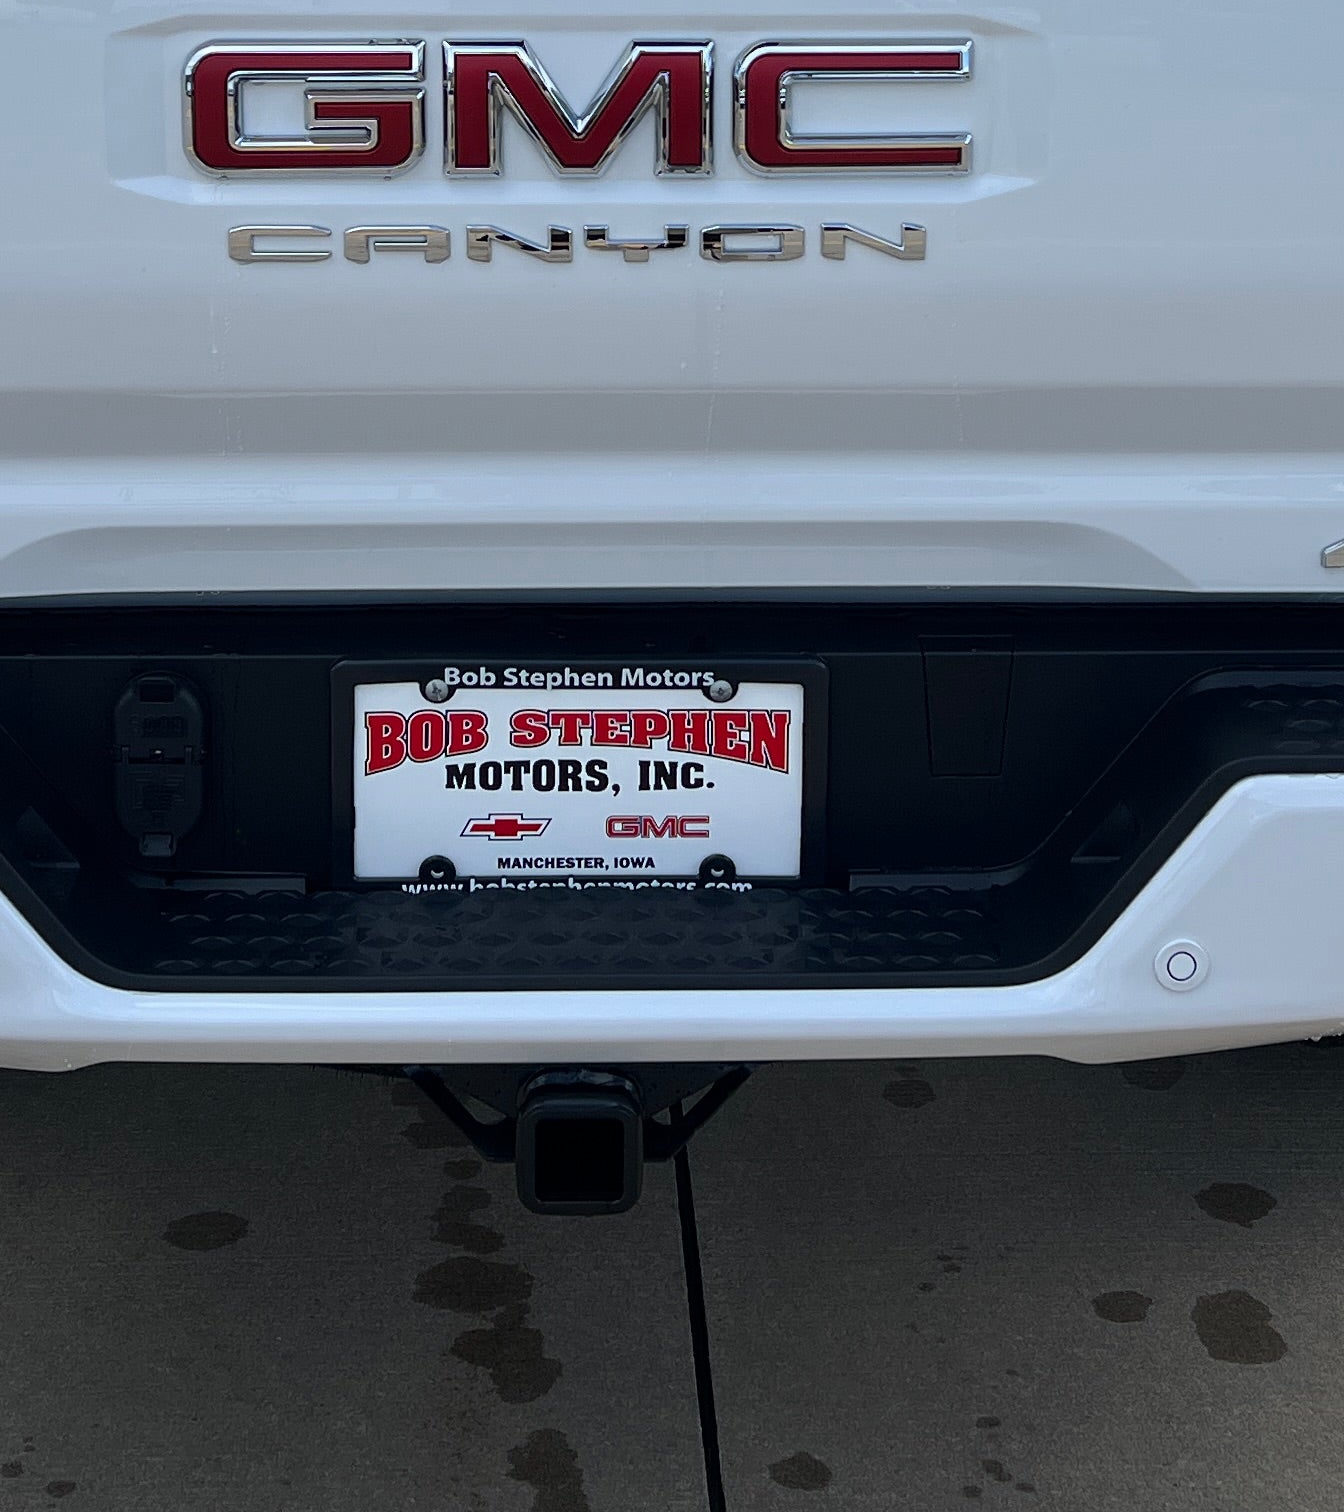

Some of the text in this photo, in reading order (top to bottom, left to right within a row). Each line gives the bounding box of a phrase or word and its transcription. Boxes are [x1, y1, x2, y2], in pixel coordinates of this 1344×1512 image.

[182, 37, 975, 179] GMC
[227, 222, 928, 265] CANYON
[444, 667, 715, 691] Bob Stephen Motors
[364, 708, 792, 775] BOB STEPHEN
[444, 759, 716, 797] MOTORS, INC.
[605, 814, 711, 840] GMC
[496, 856, 656, 872] MANCHESTER, IOWA
